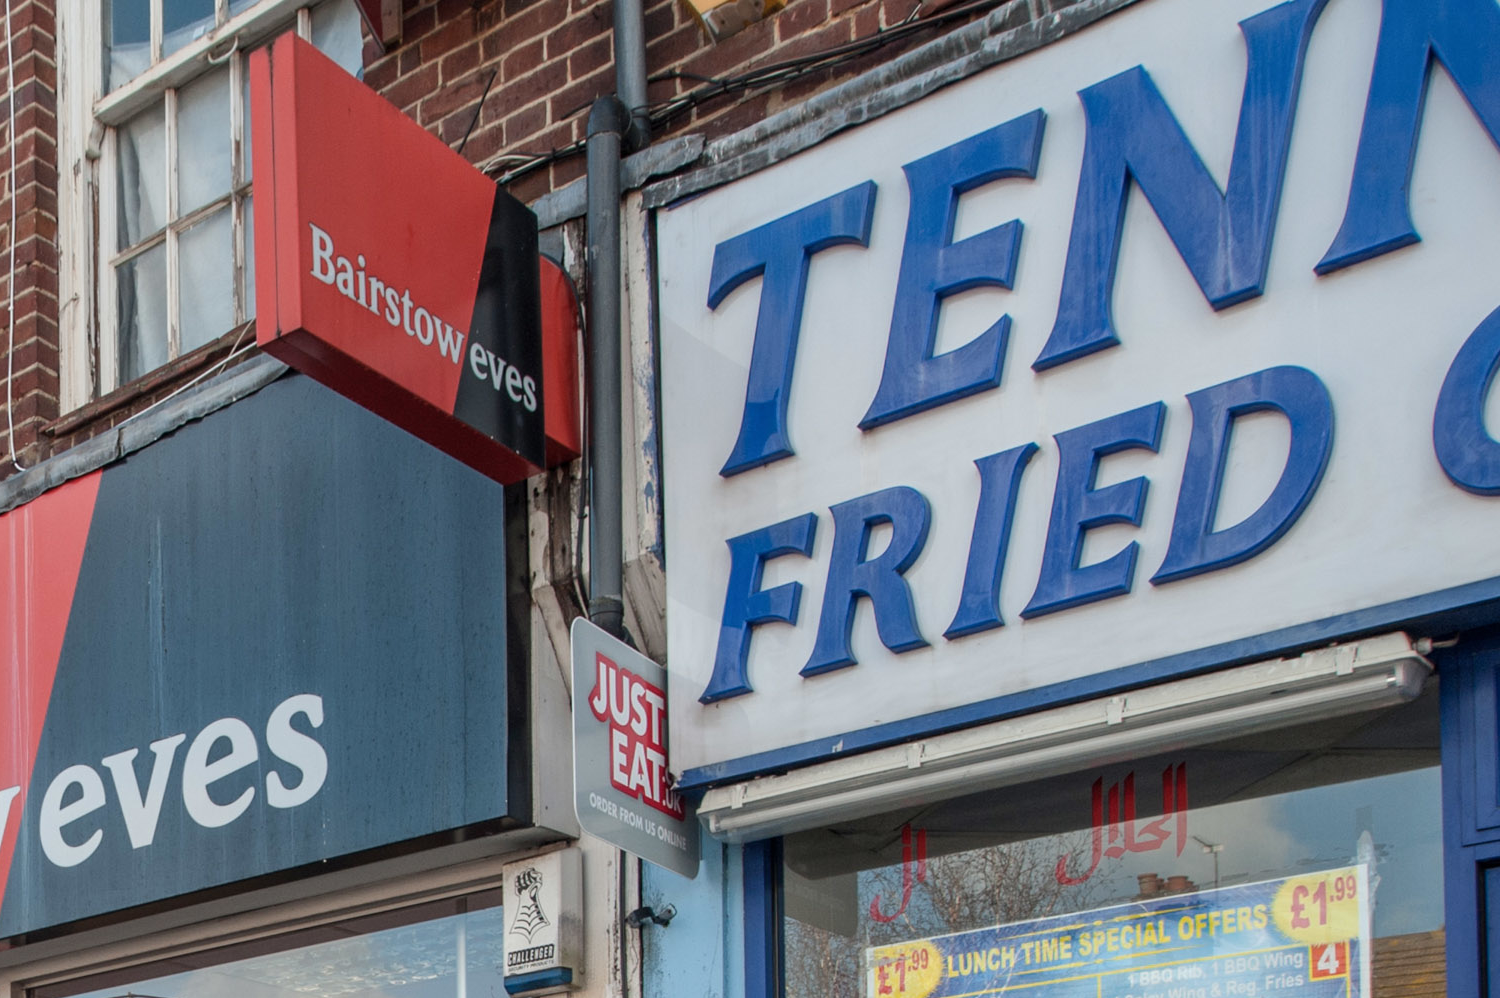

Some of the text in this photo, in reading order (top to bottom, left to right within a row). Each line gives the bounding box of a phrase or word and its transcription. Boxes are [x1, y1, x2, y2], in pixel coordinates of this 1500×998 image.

[308, 222, 537, 413] Bairstow eves
[698, 365, 1334, 705] FRIED
[592, 662, 664, 745] JUST
[38, 693, 329, 869] eves
[612, 728, 666, 804] EAT
[589, 792, 687, 851] ORDER FROM US ONLINE
[1290, 875, 1357, 930] £1.99
[507, 944, 554, 966] CHALLENGER
[946, 904, 1268, 979] LUNCH TIME SPECIAL OFFERS
[1139, 950, 1304, 987] BBQ BBQ Wing
[1317, 943, 1340, 975] 4
[877, 948, 929, 996] £1.99
[1210, 982, 1222, 997] &
[1227, 978, 1261, 997] Reg.
[1265, 973, 1304, 991] Fries
